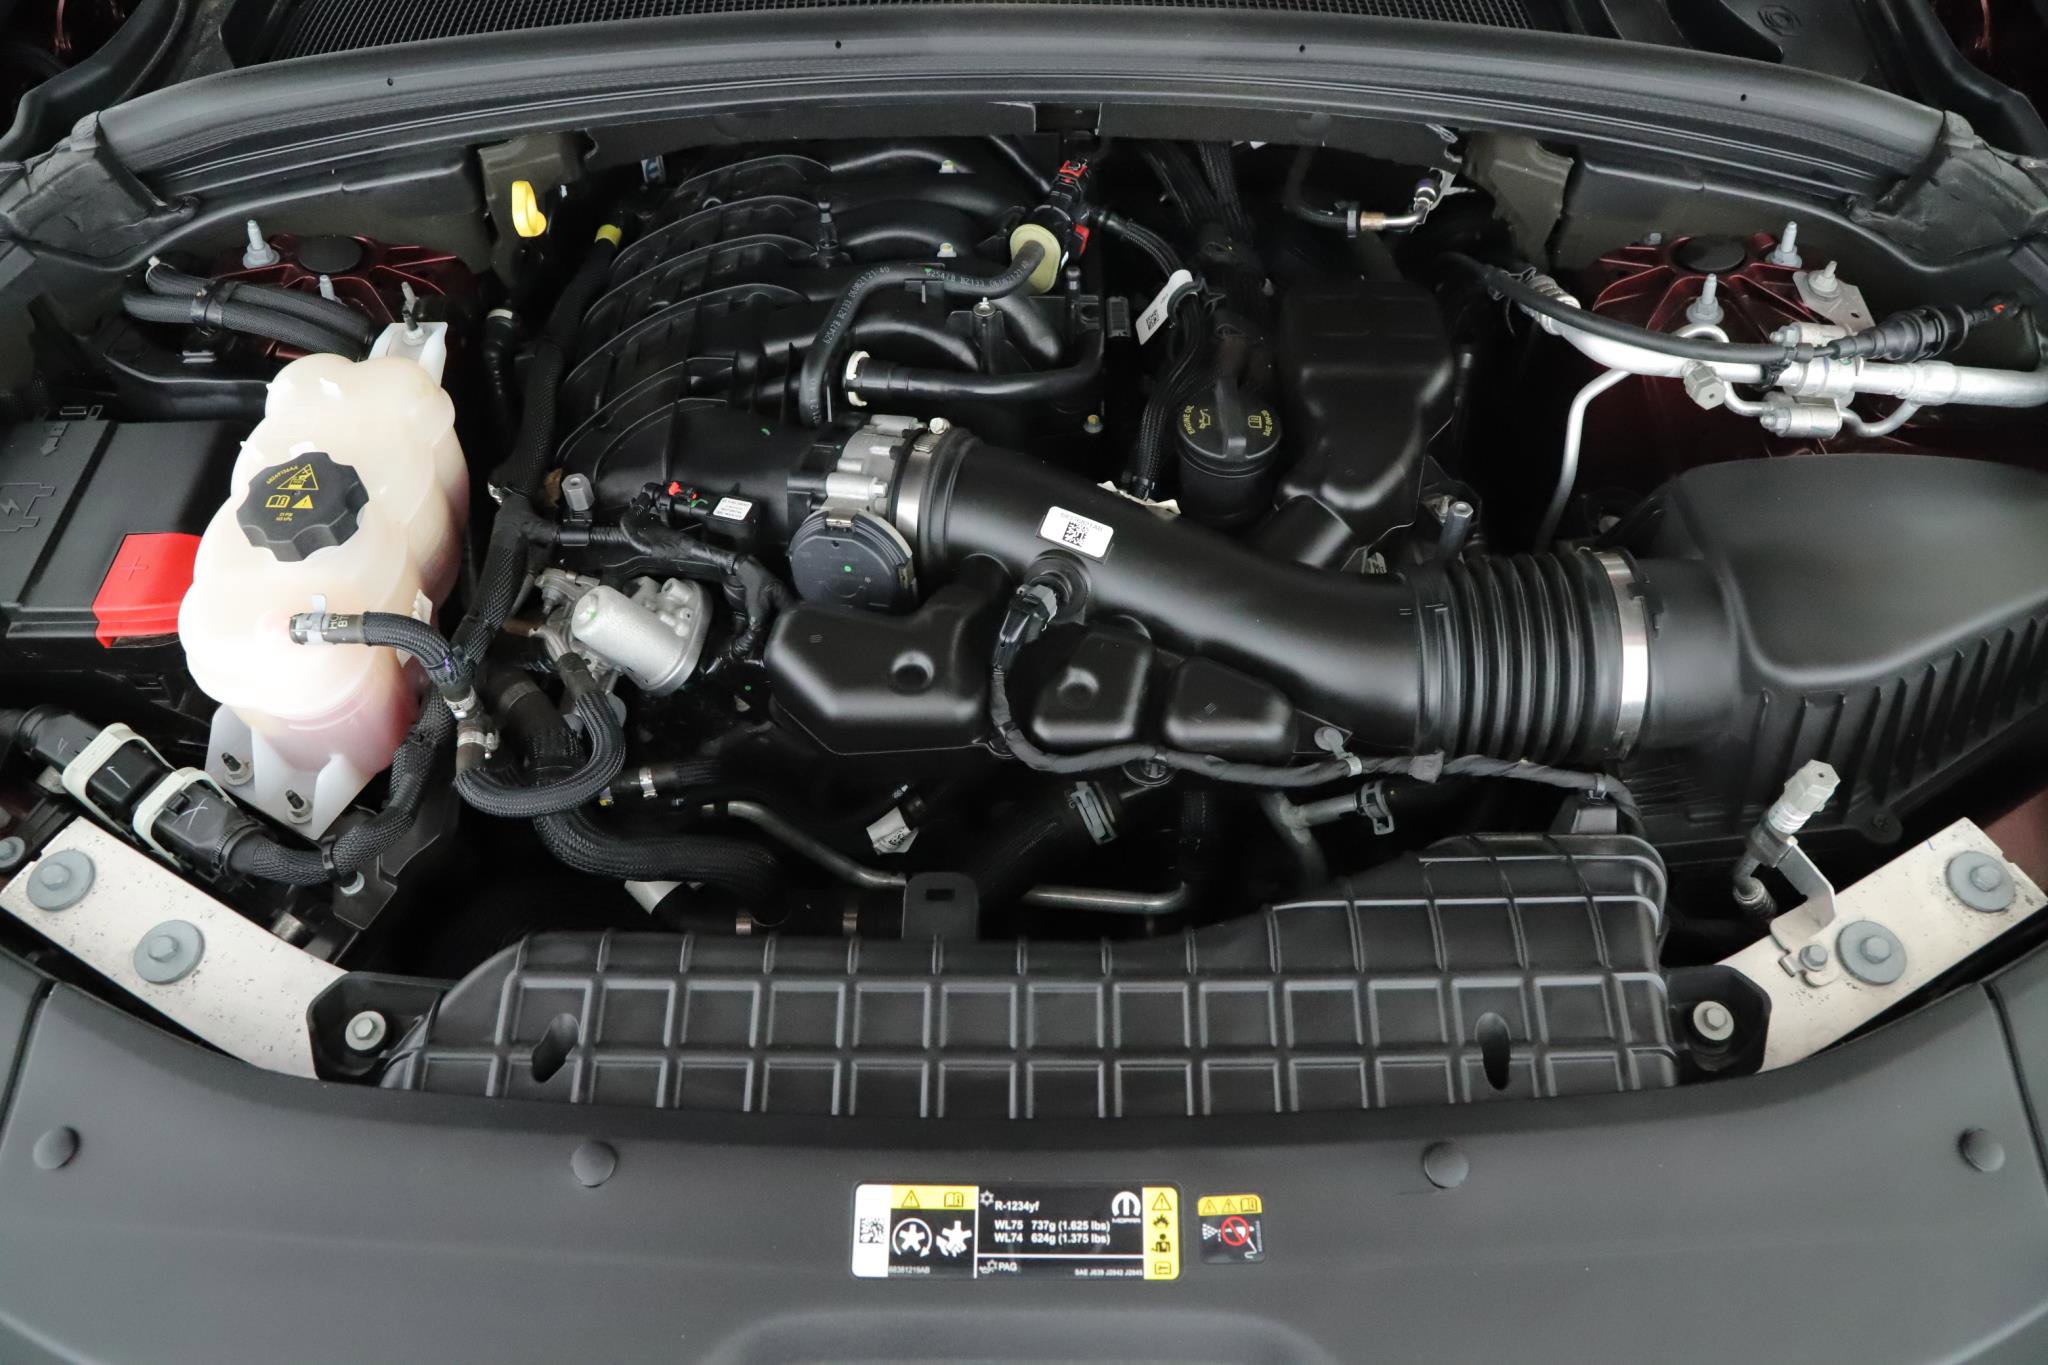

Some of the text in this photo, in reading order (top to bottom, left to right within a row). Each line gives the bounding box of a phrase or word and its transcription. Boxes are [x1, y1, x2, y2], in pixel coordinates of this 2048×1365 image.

[1183, 413, 1196, 435] ENGINE
[994, 1200, 1040, 1213] R-1234yf
[993, 1219, 1111, 1233] WL75 737g (1.625 lbs)
[993, 1232, 1111, 1246] WL74 624g (1.375 lbs)
[998, 1261, 1018, 1272] PAG
